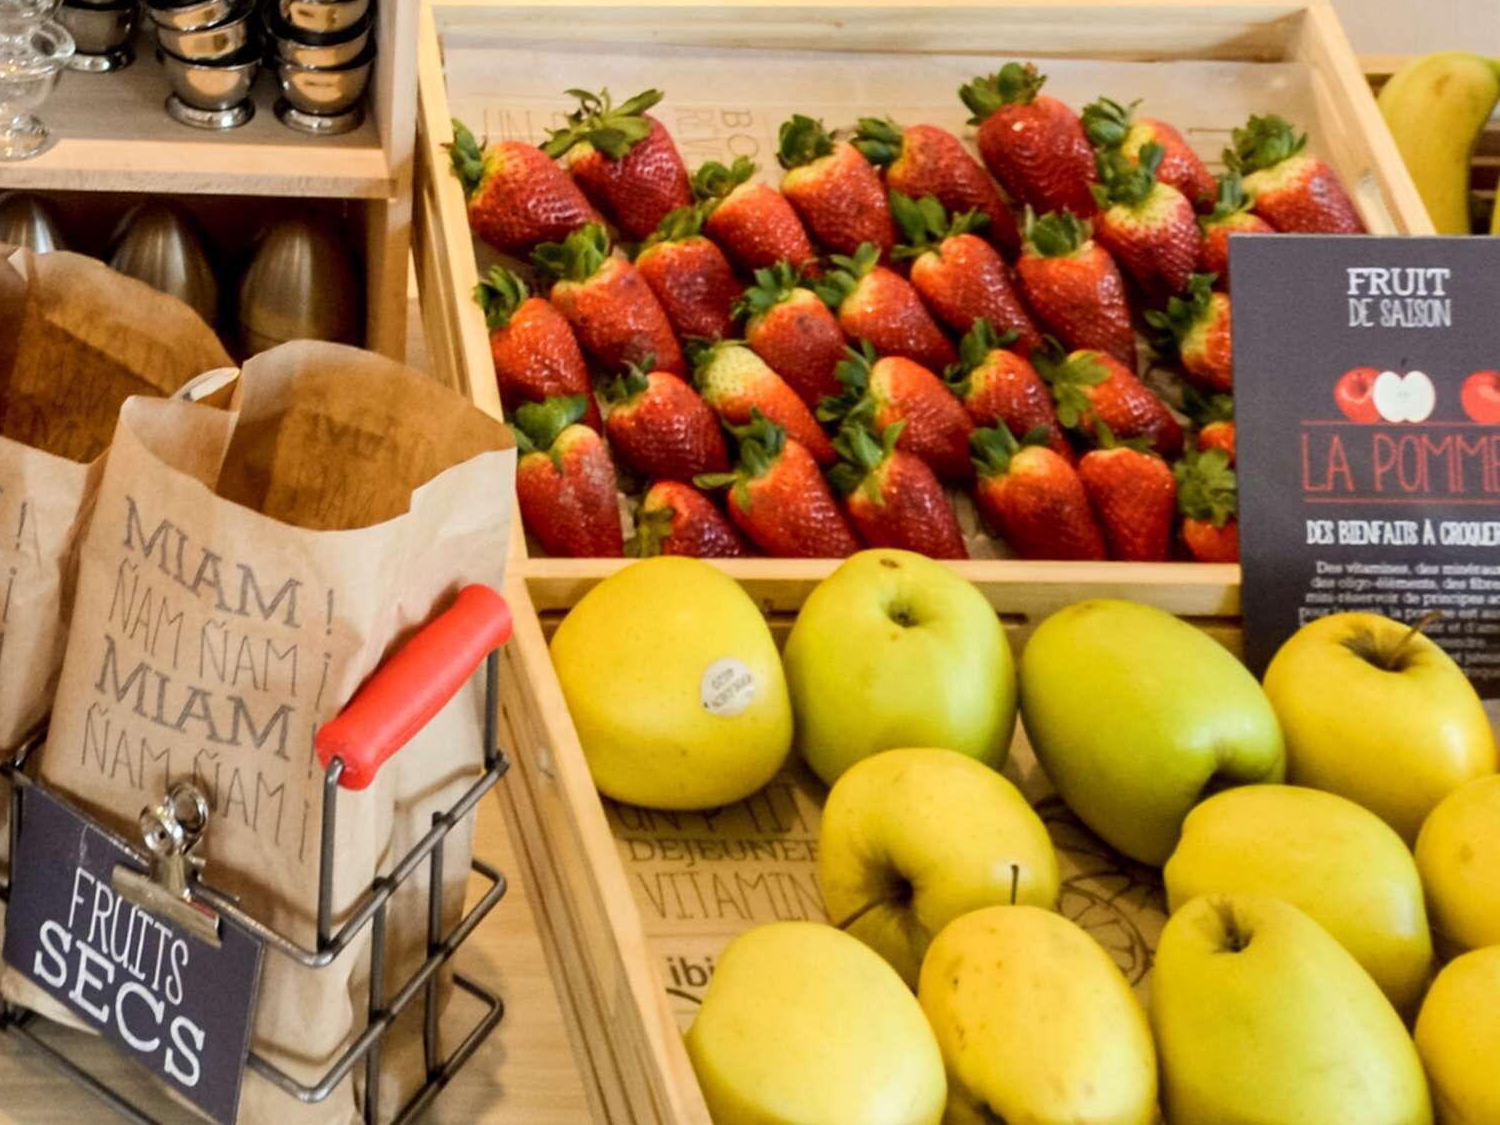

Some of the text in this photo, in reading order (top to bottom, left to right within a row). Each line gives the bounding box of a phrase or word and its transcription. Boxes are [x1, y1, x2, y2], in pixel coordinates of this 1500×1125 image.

[1347, 267, 1451, 297] FRUIT
[1348, 297, 1452, 328] DE SAISON
[1302, 432, 1355, 493] LA
[123, 495, 303, 629] MIAM
[1306, 520, 1335, 545] DES
[1338, 520, 1420, 546] BIENFAITS
[95, 634, 296, 762] MIAM
[67, 866, 189, 1006] FRUITS
[666, 956, 715, 987] ibi
[33, 919, 206, 1088] SECS
